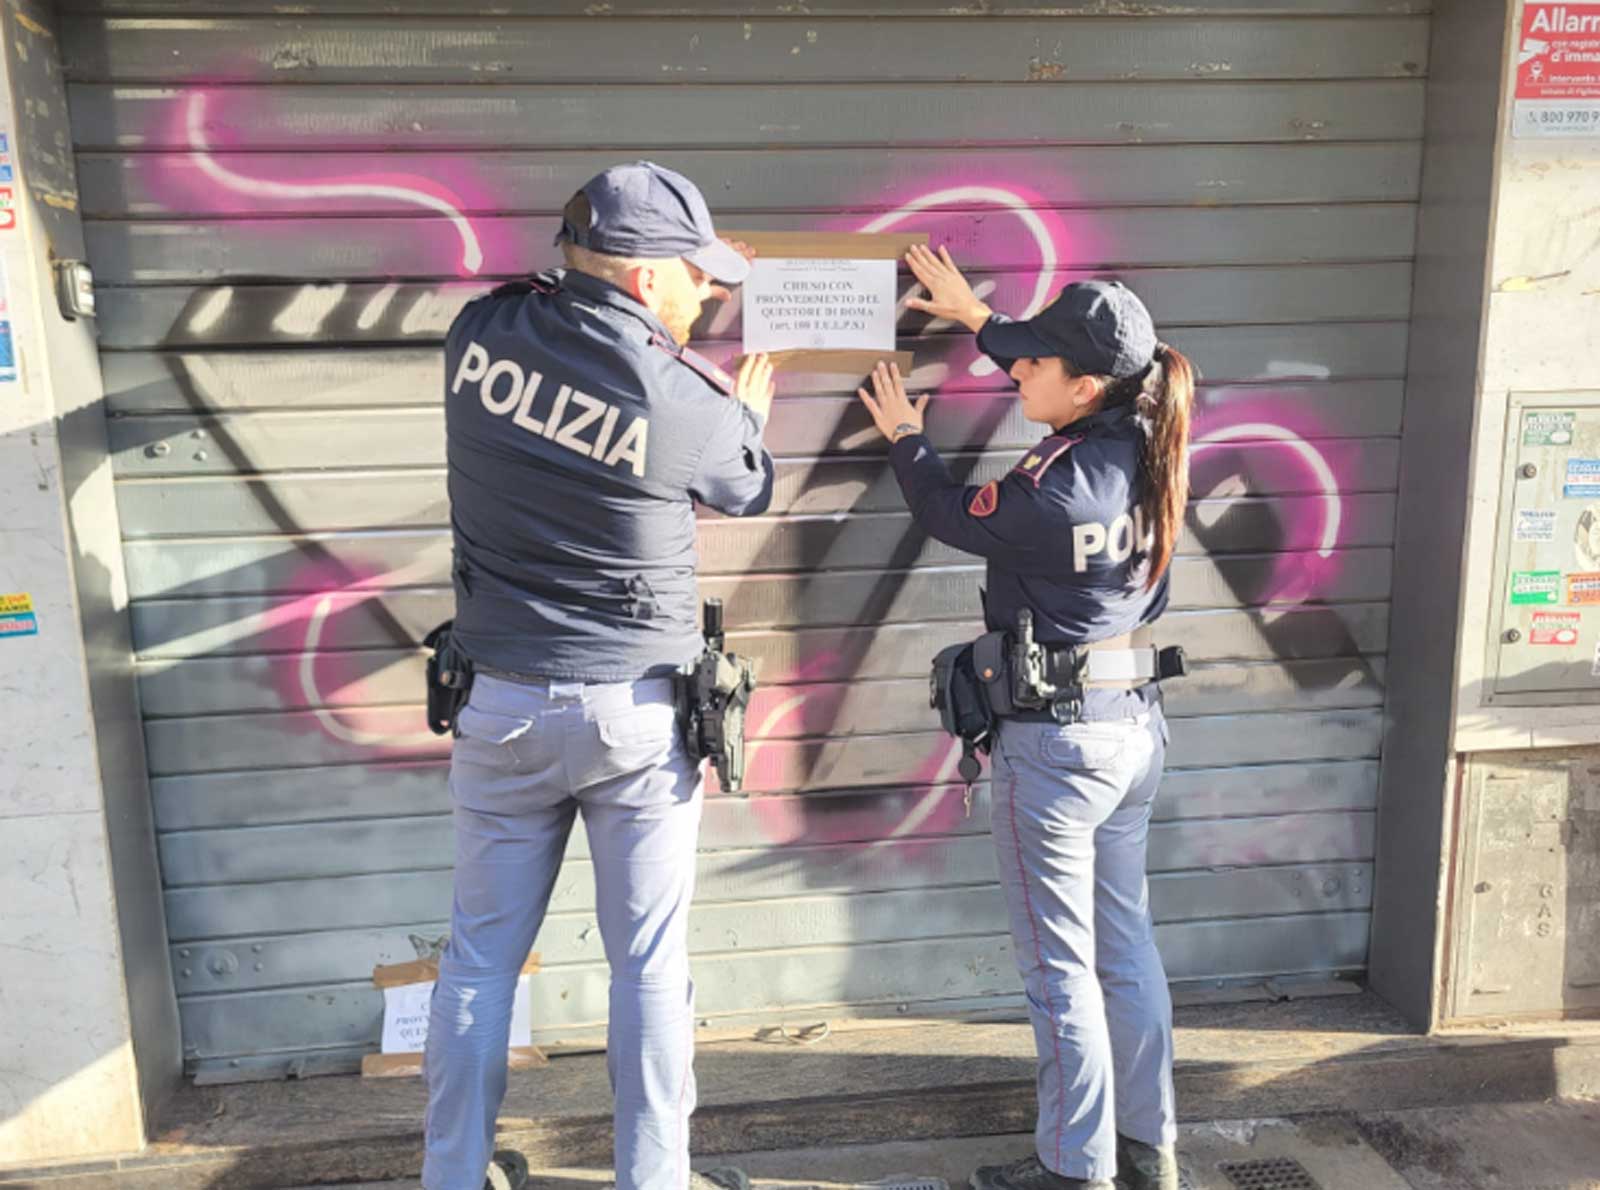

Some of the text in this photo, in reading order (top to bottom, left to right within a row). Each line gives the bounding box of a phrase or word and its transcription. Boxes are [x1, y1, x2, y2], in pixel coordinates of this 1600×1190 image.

[1541, 111, 1564, 123] 800
[1567, 111, 1589, 123] 970
[828, 281, 854, 290] CON
[858, 294, 880, 304] DEL
[761, 307, 874, 319] QUESTORE DI ROMA
[451, 341, 649, 478] POLIZIA
[1537, 883, 1552, 938] GAS
